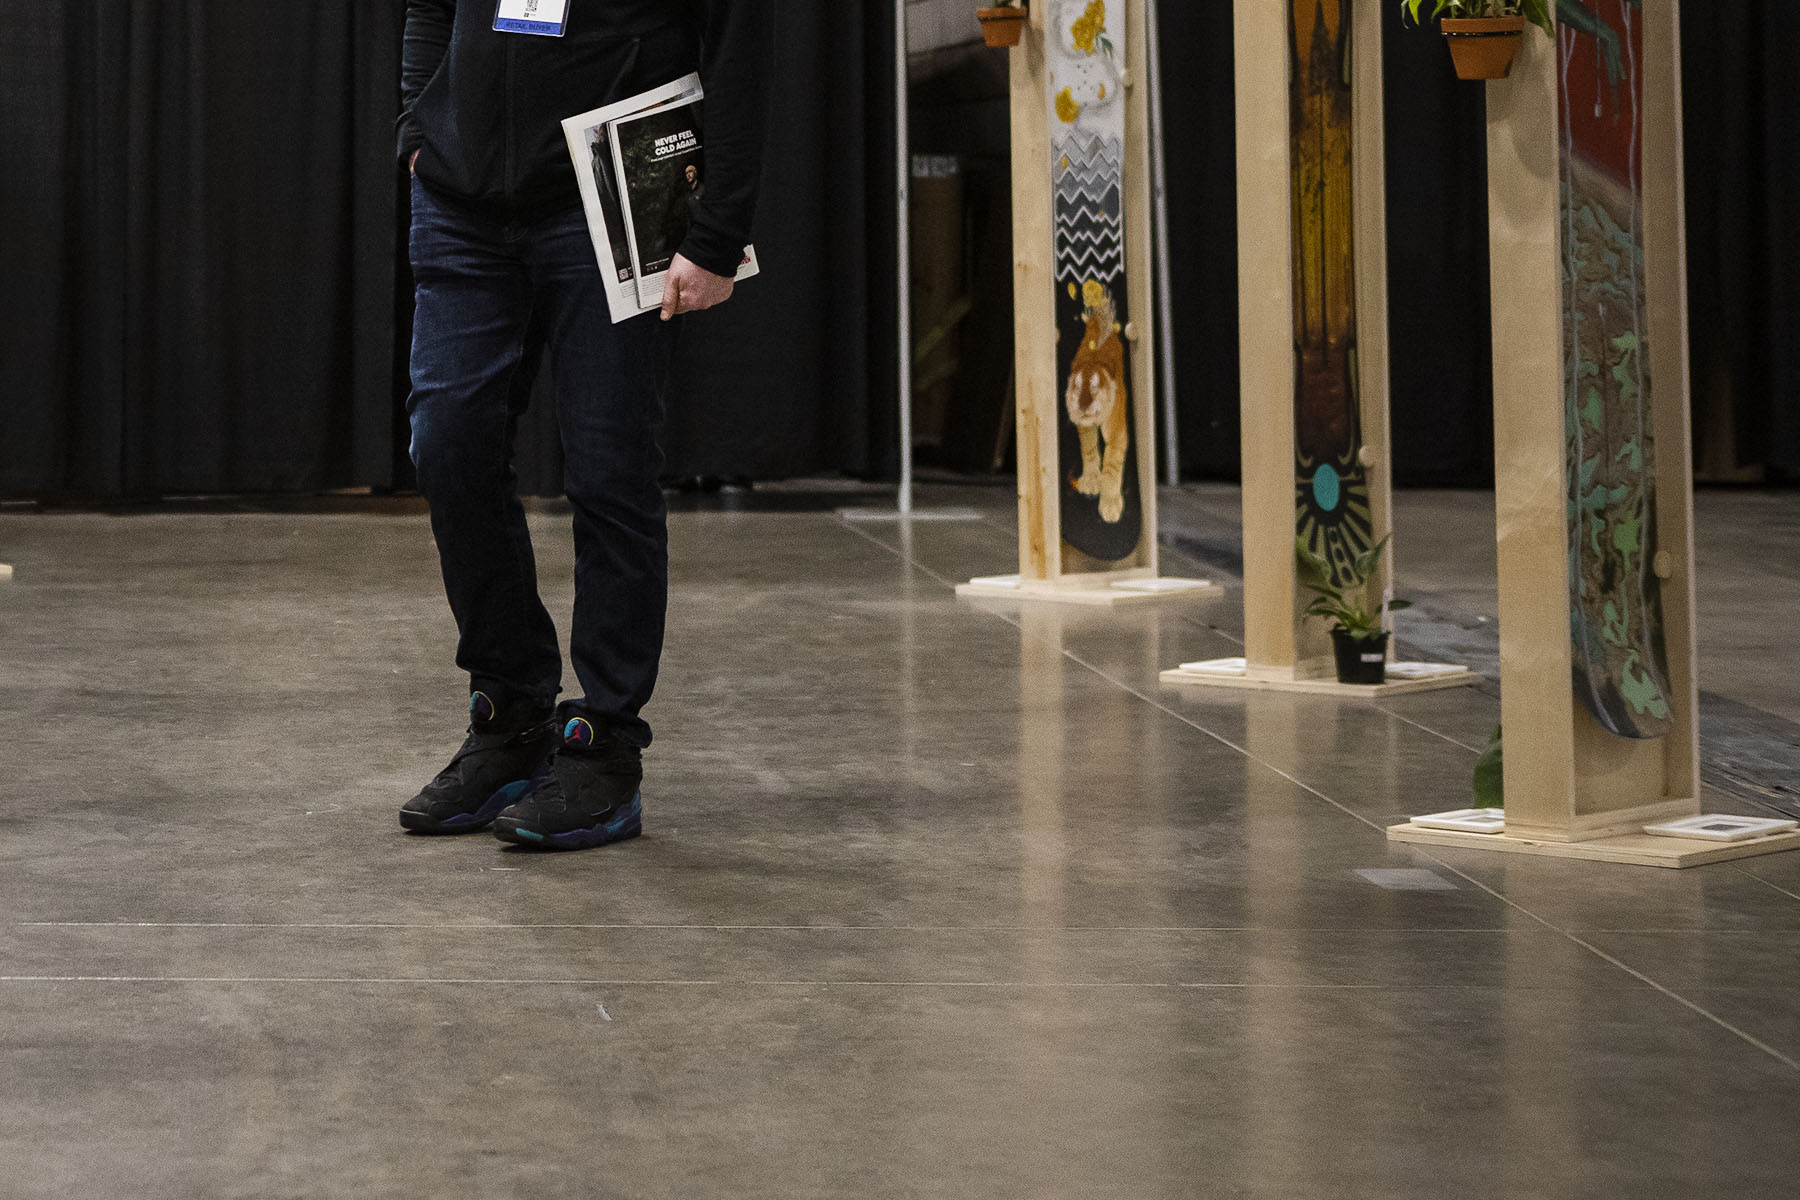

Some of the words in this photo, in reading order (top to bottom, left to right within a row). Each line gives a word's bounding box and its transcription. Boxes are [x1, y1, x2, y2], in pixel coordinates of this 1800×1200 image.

[654, 134, 678, 147] NEVER
[678, 130, 694, 140] FEEL
[655, 144, 675, 156] COLD
[676, 137, 697, 150] AGAIN
